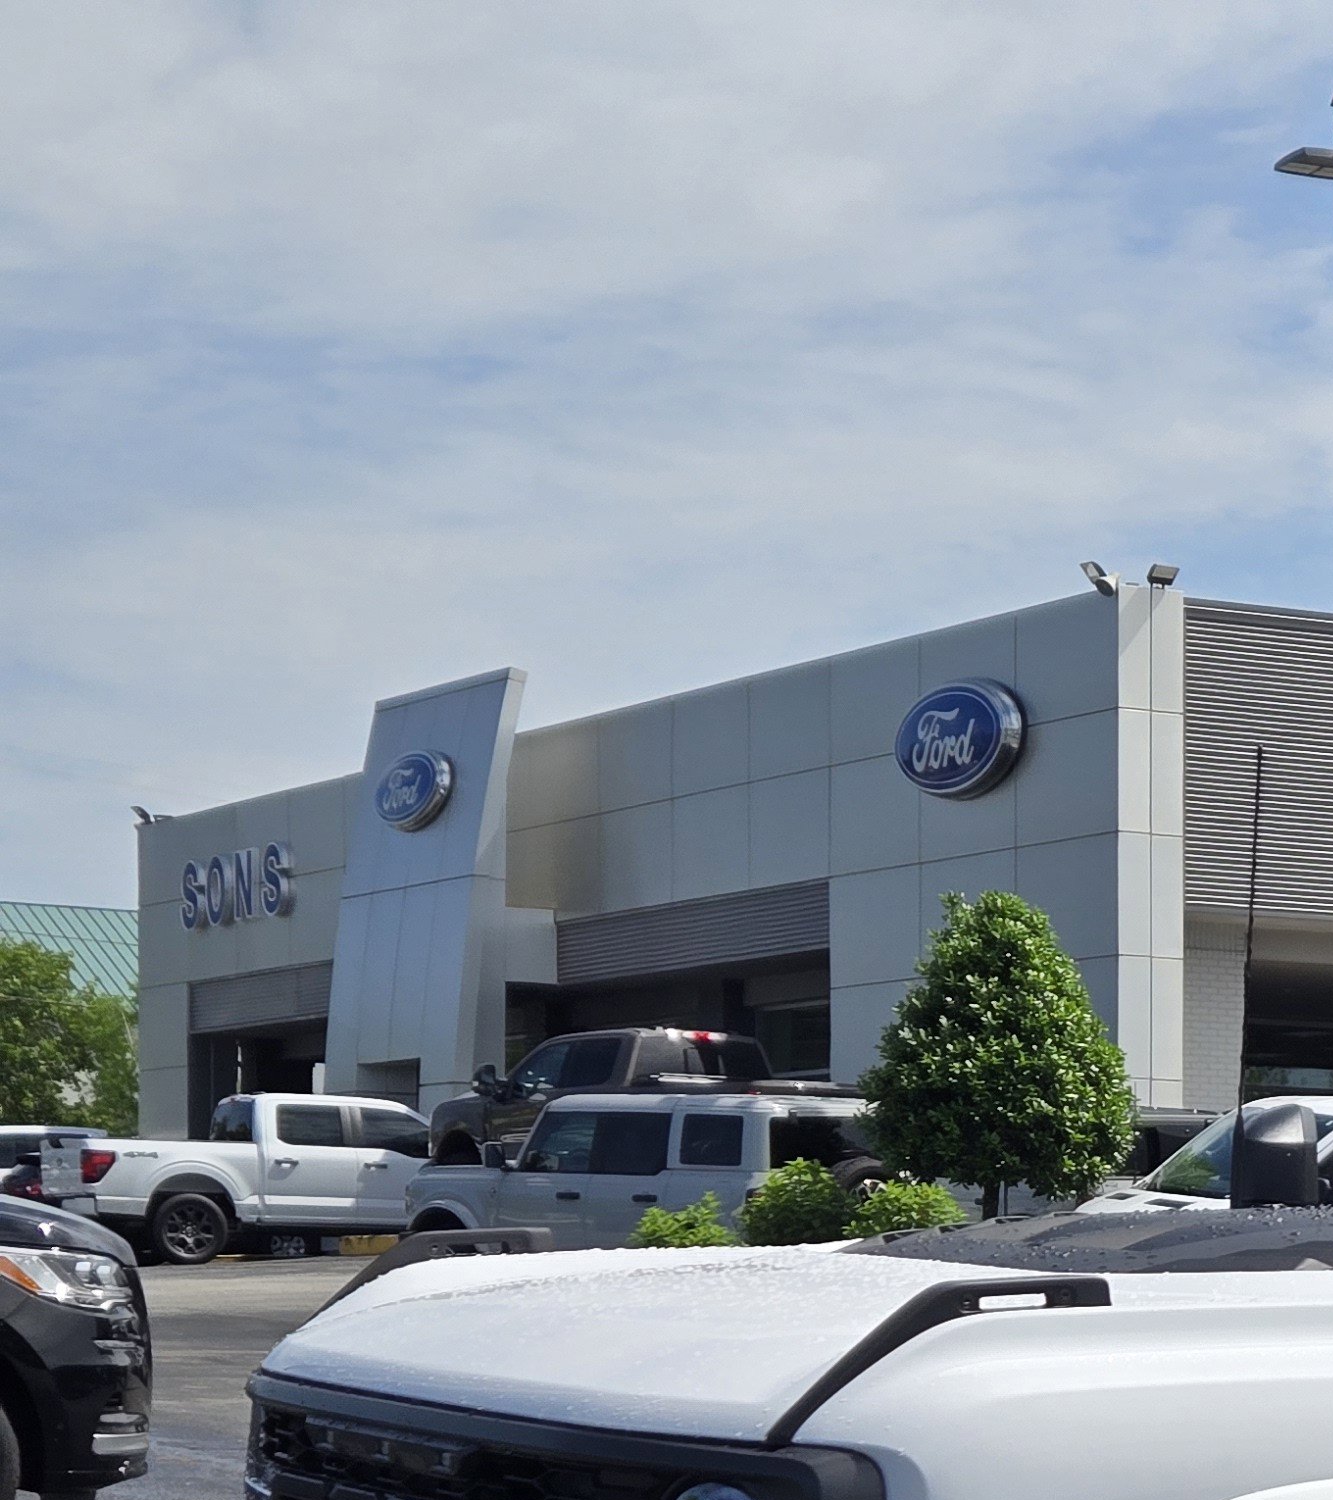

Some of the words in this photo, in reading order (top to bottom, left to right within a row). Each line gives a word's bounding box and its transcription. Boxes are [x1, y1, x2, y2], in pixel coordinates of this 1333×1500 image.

[912, 707, 976, 773] Ford
[382, 767, 422, 811] Ford
[180, 842, 287, 931] SONS
